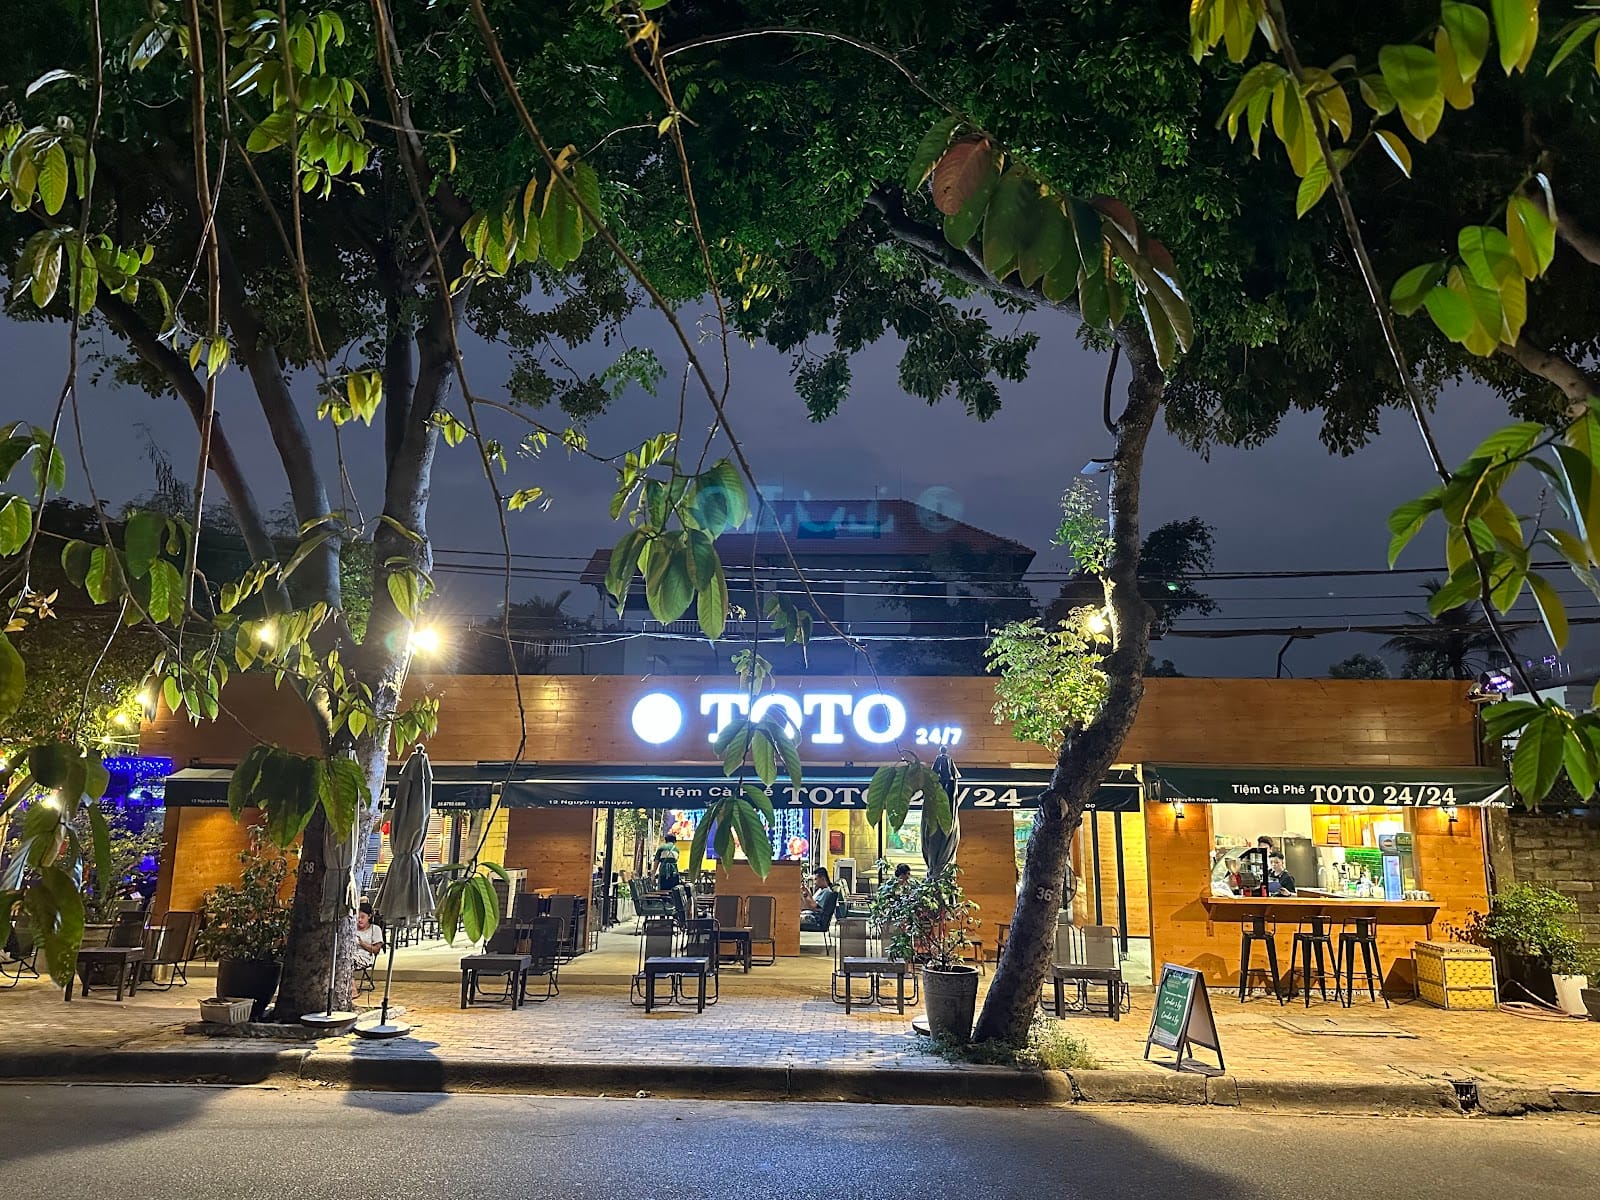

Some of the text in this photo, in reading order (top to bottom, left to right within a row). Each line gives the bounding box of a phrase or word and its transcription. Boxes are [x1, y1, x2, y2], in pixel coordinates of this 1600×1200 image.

[700, 693, 962, 745] TOTO 24/7
[657, 786, 702, 798] Tiệm
[709, 785, 733, 797] Cà
[909, 787, 1023, 808] 2/24
[1232, 784, 1260, 796] Tiệm
[1264, 784, 1279, 795] Cà
[1283, 784, 1306, 795] Phê
[1310, 784, 1375, 804] TOTO
[1383, 785, 1457, 807] 24/24
[1036, 886, 1054, 901] 36
